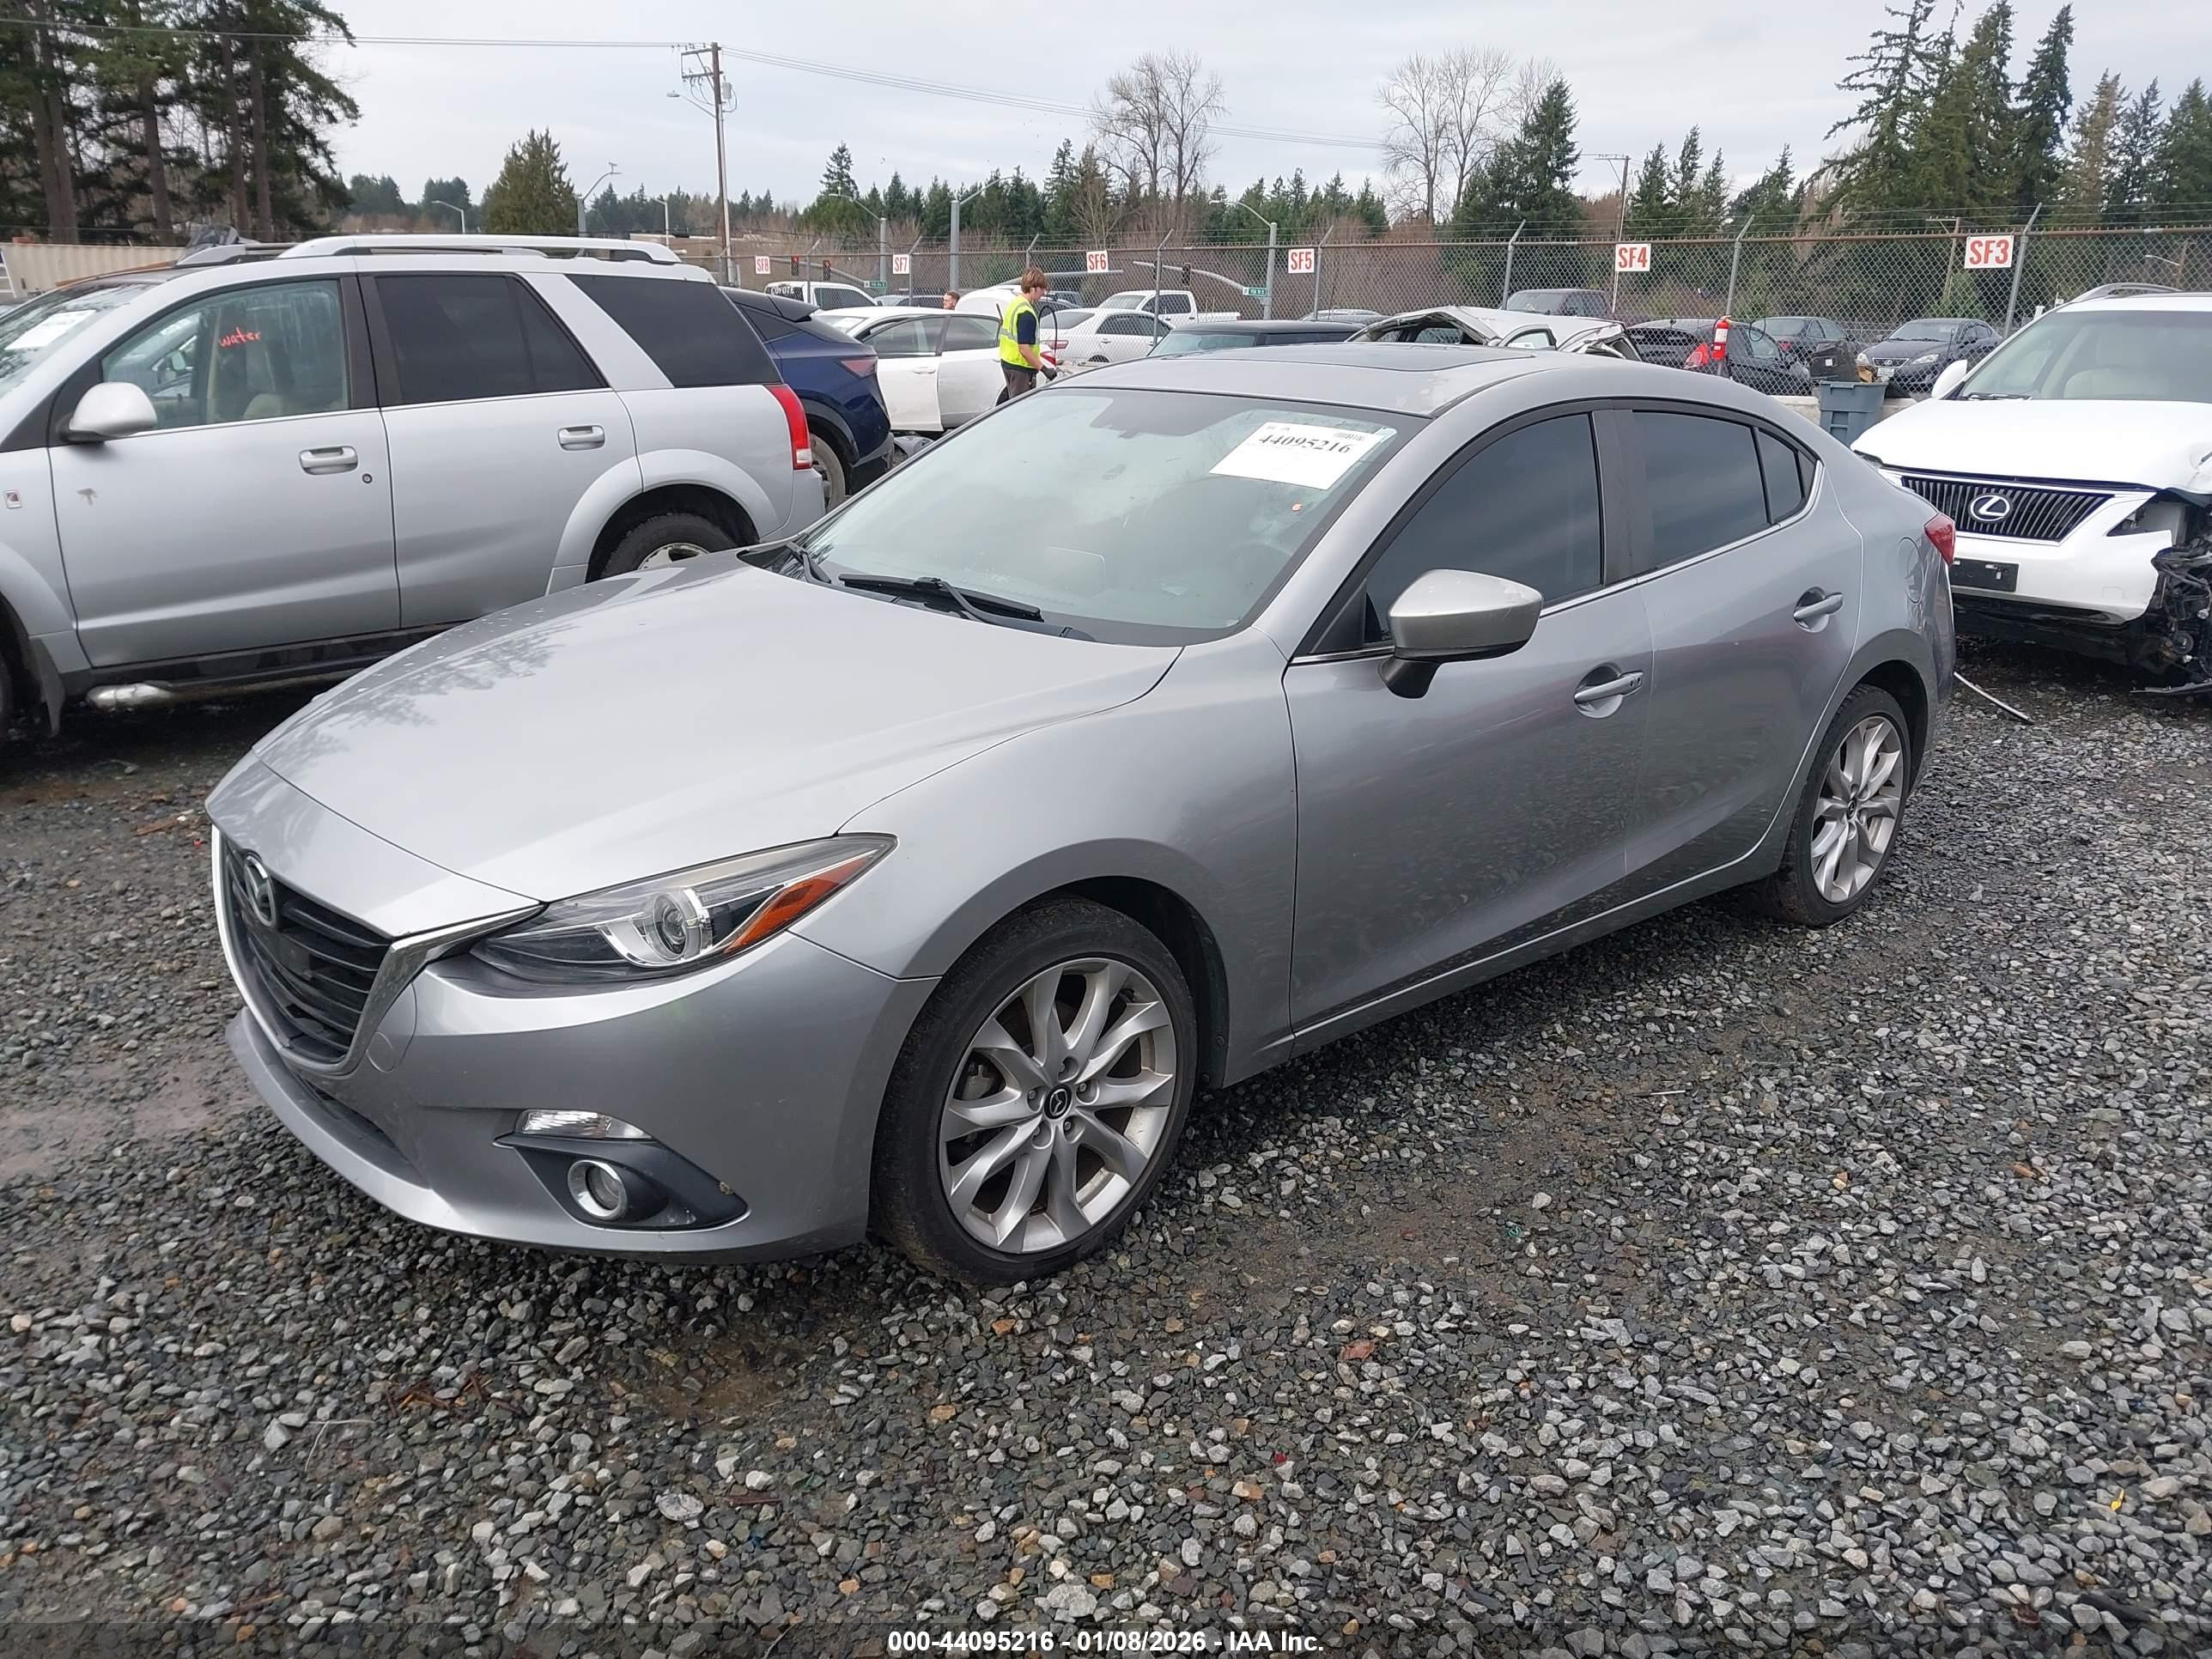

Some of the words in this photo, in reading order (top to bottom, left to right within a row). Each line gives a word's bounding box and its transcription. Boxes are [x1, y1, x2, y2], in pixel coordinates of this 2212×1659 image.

[1087, 252, 1108, 271] SF6
[1290, 251, 1313, 270] SF5
[1617, 246, 1649, 269] SF4
[1968, 240, 2011, 265] SF3
[757, 258, 769, 272] SF8
[894, 257, 908, 272] SF7
[218, 326, 262, 348] water
[1258, 434, 1356, 453] 44095216
